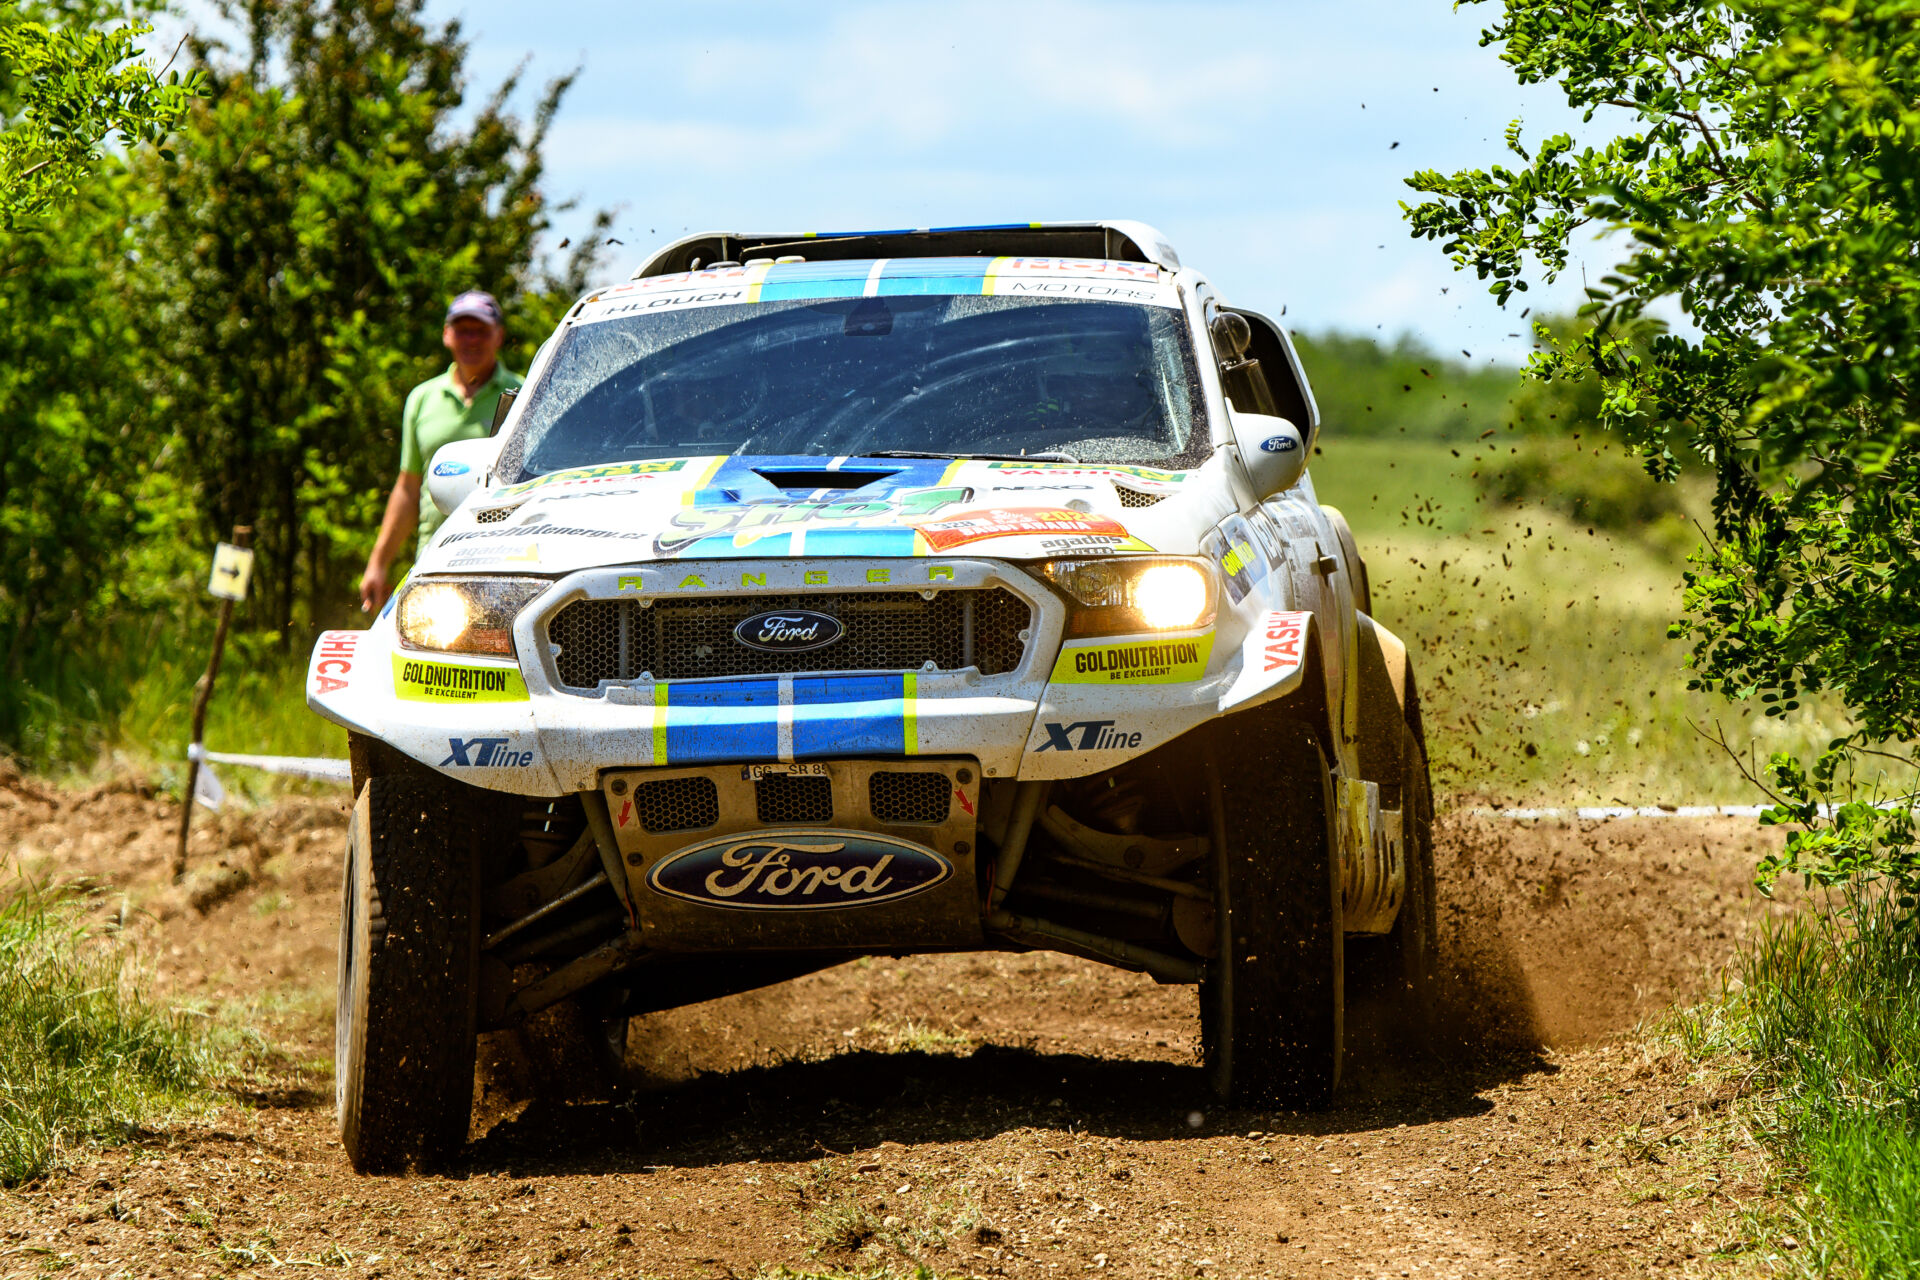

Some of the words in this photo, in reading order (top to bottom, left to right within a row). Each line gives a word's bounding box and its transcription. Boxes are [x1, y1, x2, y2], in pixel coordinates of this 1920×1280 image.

[1012, 282, 1156, 300] MOTORS
[1268, 437, 1293, 451] Ford
[538, 489, 640, 504] NEXO
[1021, 521, 1093, 531] ARABIA
[1040, 535, 1123, 549] agados
[618, 566, 954, 590] RANGER
[758, 616, 820, 642] Ford
[1075, 643, 1199, 674] GOLDNUTRITION
[402, 661, 507, 692] GOLDNUTRITION
[1110, 671, 1122, 680] BE
[1123, 667, 1171, 679] EXCELLENT
[424, 686, 434, 695] BE
[435, 688, 478, 700] EXCELLENT
[1034, 719, 1143, 752] XTline
[438, 737, 533, 768] XTline
[788, 764, 809, 775] SR
[704, 842, 896, 897] Ford
